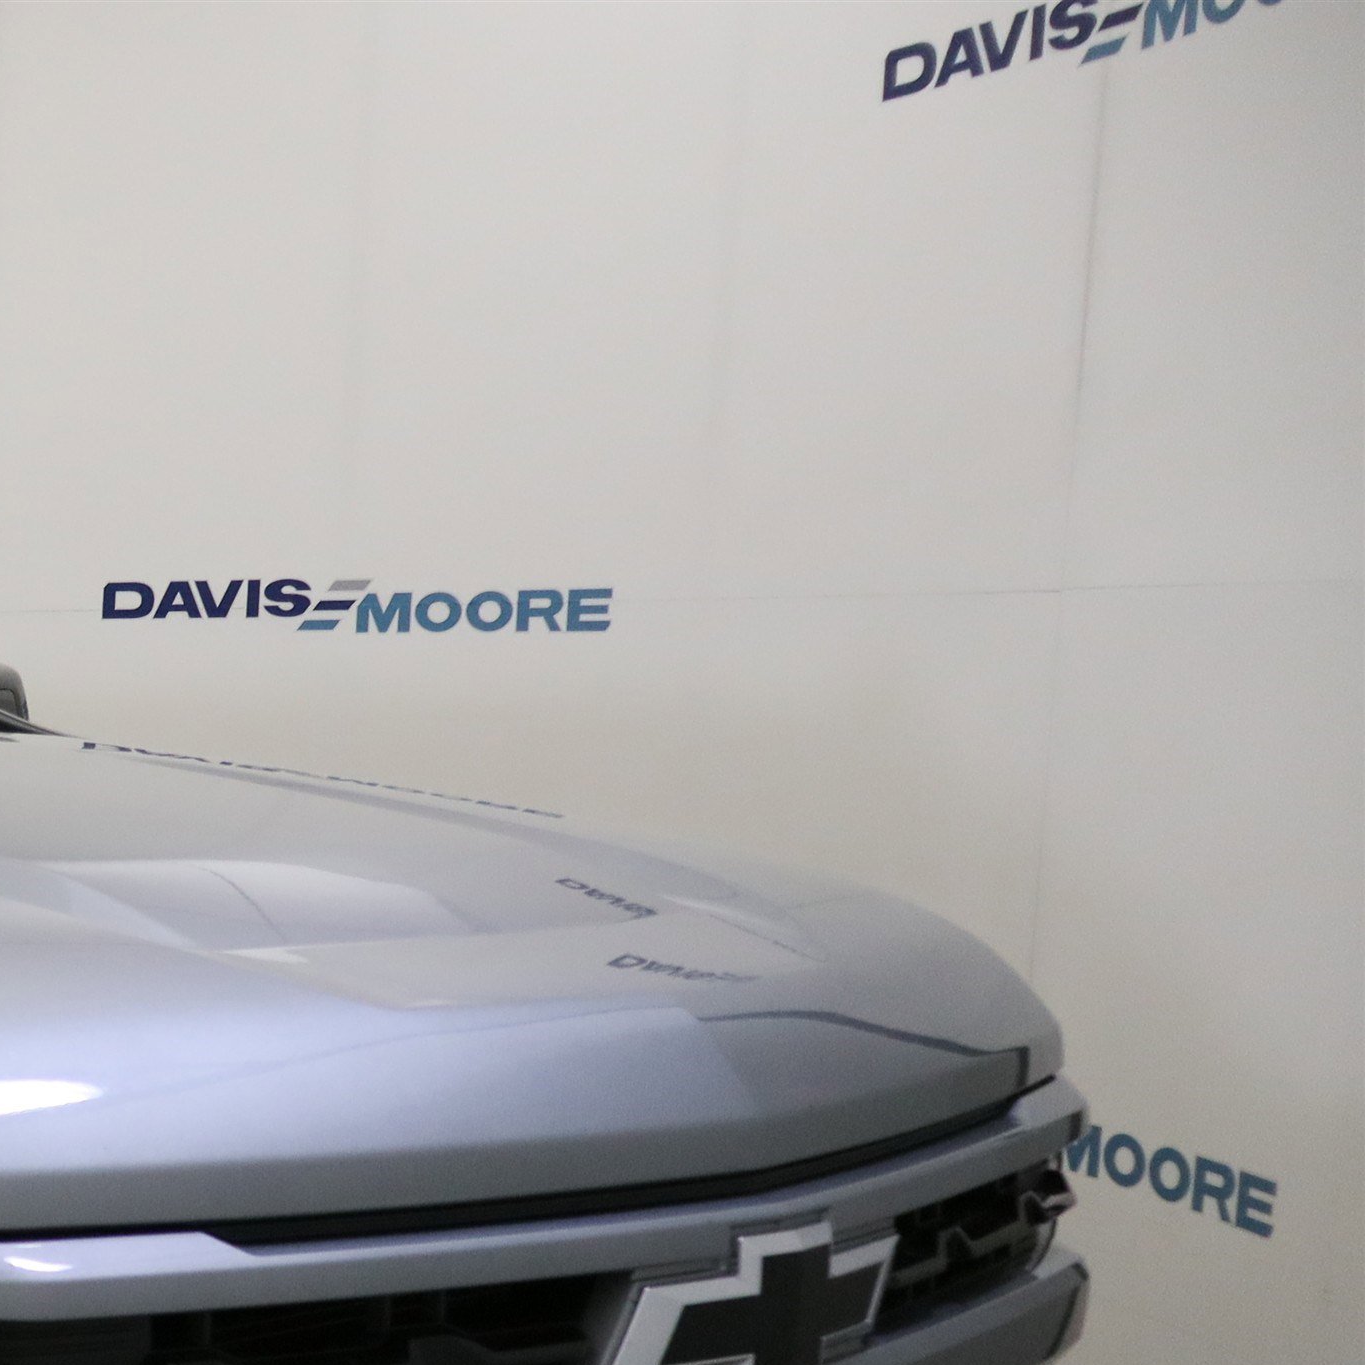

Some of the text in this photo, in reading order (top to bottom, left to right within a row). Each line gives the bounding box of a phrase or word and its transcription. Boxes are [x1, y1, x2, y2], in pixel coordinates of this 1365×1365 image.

[882, 0, 1098, 101] DAVIS
[101, 578, 613, 633] DAVIS MOORE
[1067, 1125, 1278, 1239] MOORE
